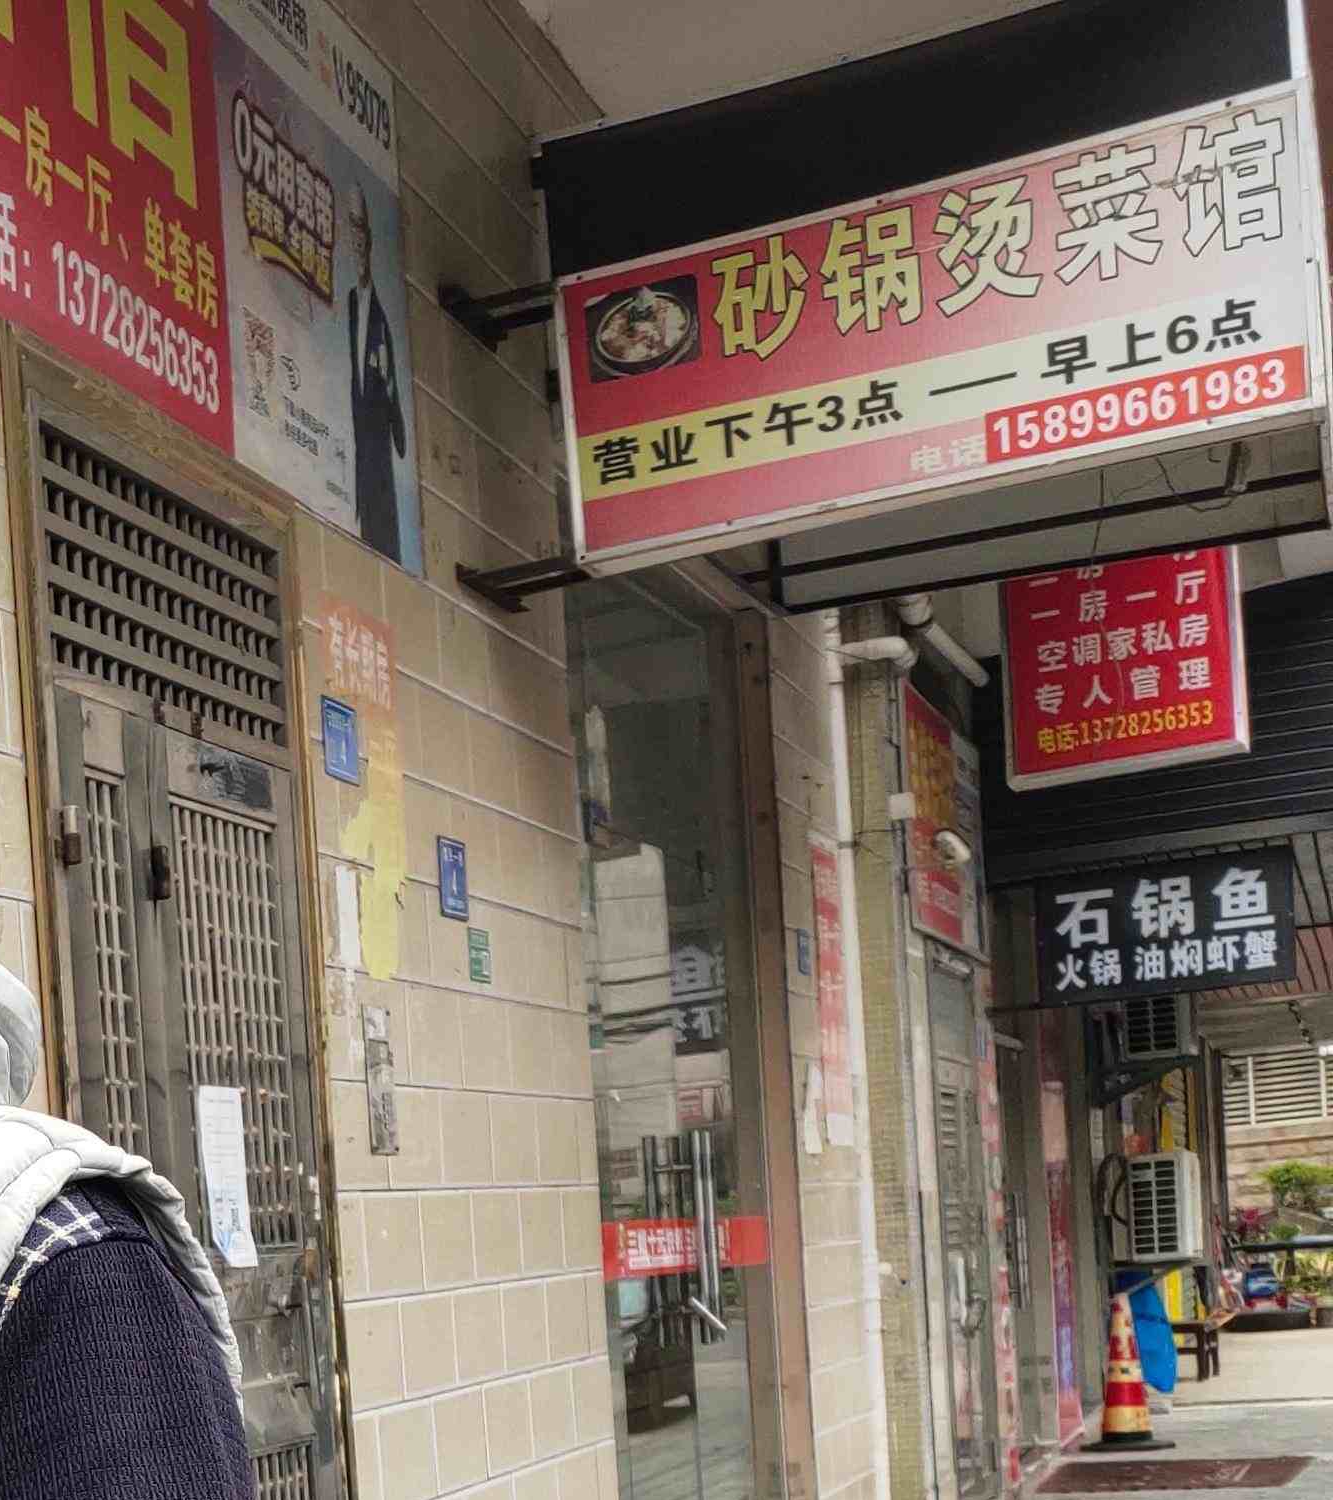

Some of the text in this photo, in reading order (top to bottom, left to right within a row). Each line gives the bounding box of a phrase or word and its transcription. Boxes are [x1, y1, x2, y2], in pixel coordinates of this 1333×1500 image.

[710, 109, 1286, 361] 砂锅烫菜馆
[908, 359, 1289, 477] 电话 15899661983
[1030, 569, 1207, 624] 一房一厅
[1036, 613, 1211, 674] 空调家私房
[1034, 656, 1211, 716] 专人管理
[1054, 866, 1276, 950] 石锅鱼
[1054, 948, 1123, 993] 火锅
